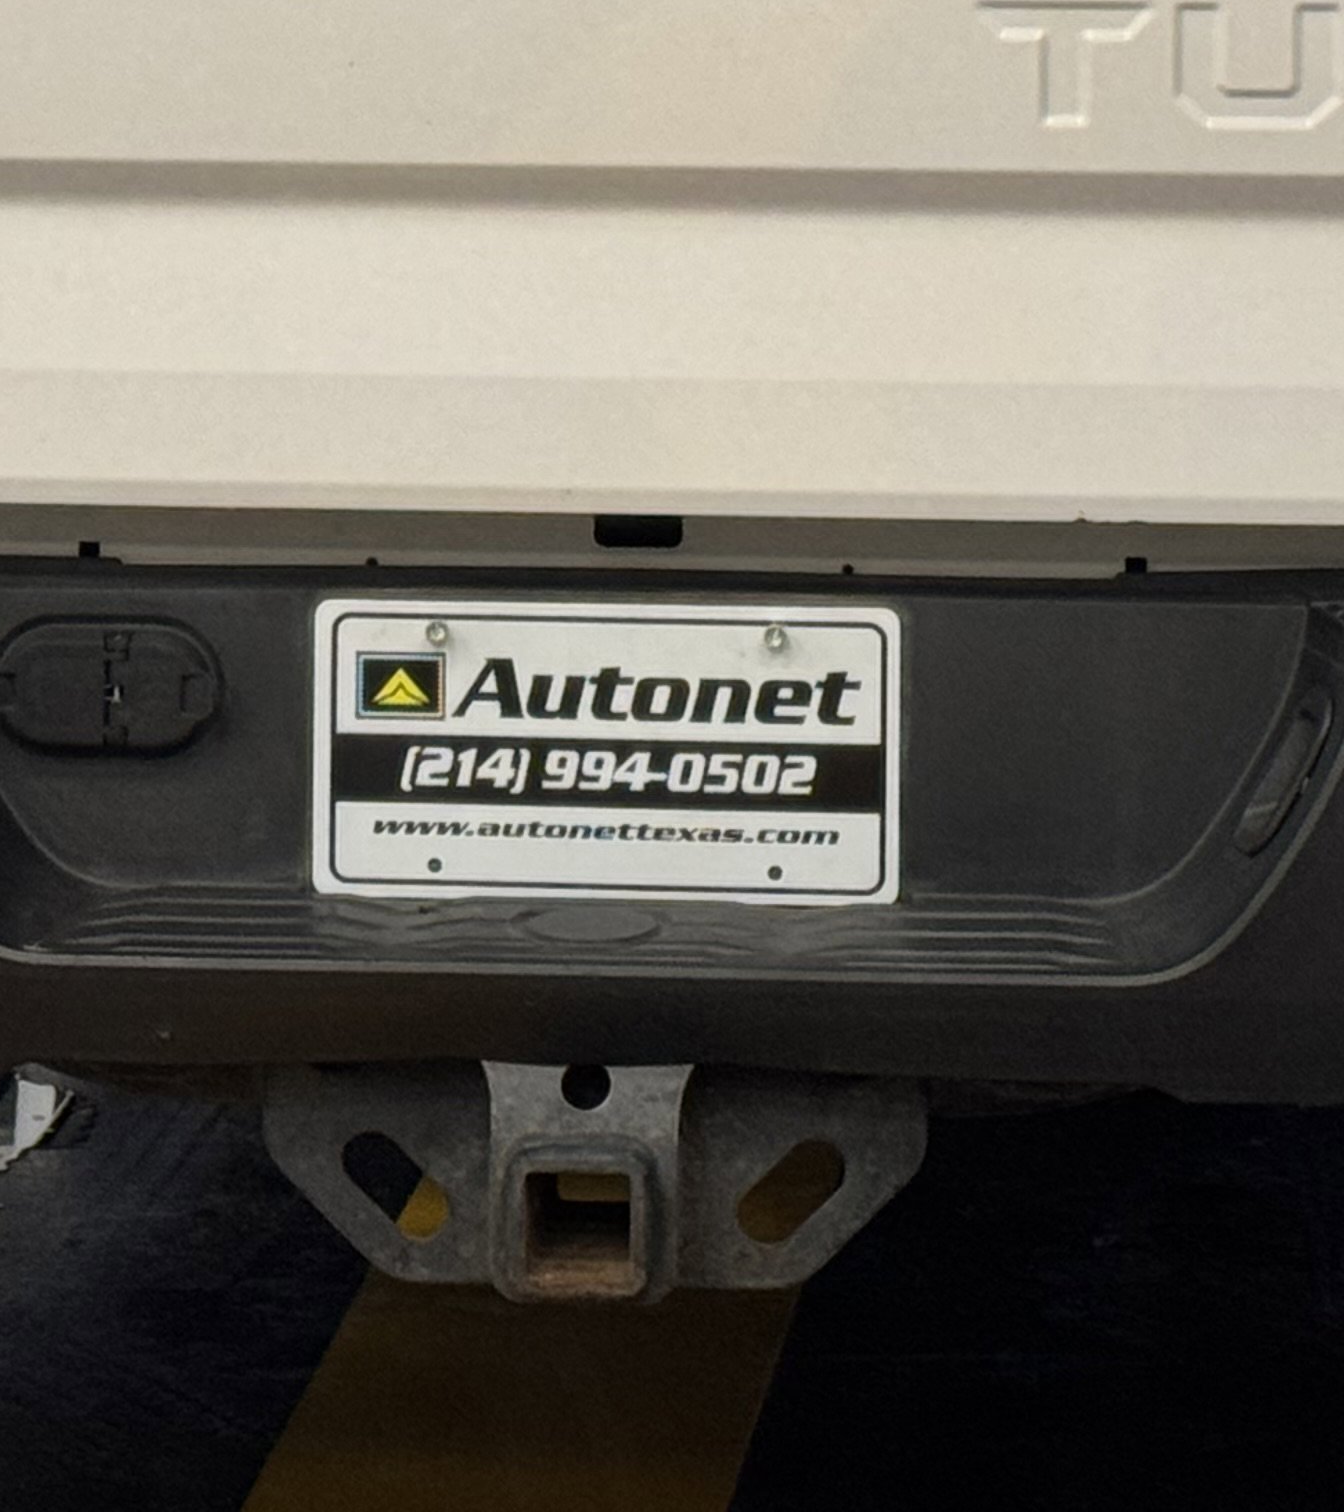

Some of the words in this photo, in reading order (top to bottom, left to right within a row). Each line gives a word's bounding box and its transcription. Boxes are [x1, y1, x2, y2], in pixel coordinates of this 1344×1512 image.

[452, 656, 862, 727] Autonet
[400, 745, 529, 795] (214)
[541, 746, 818, 796] 994-0502
[372, 817, 841, 847] www.autonettexas.com
